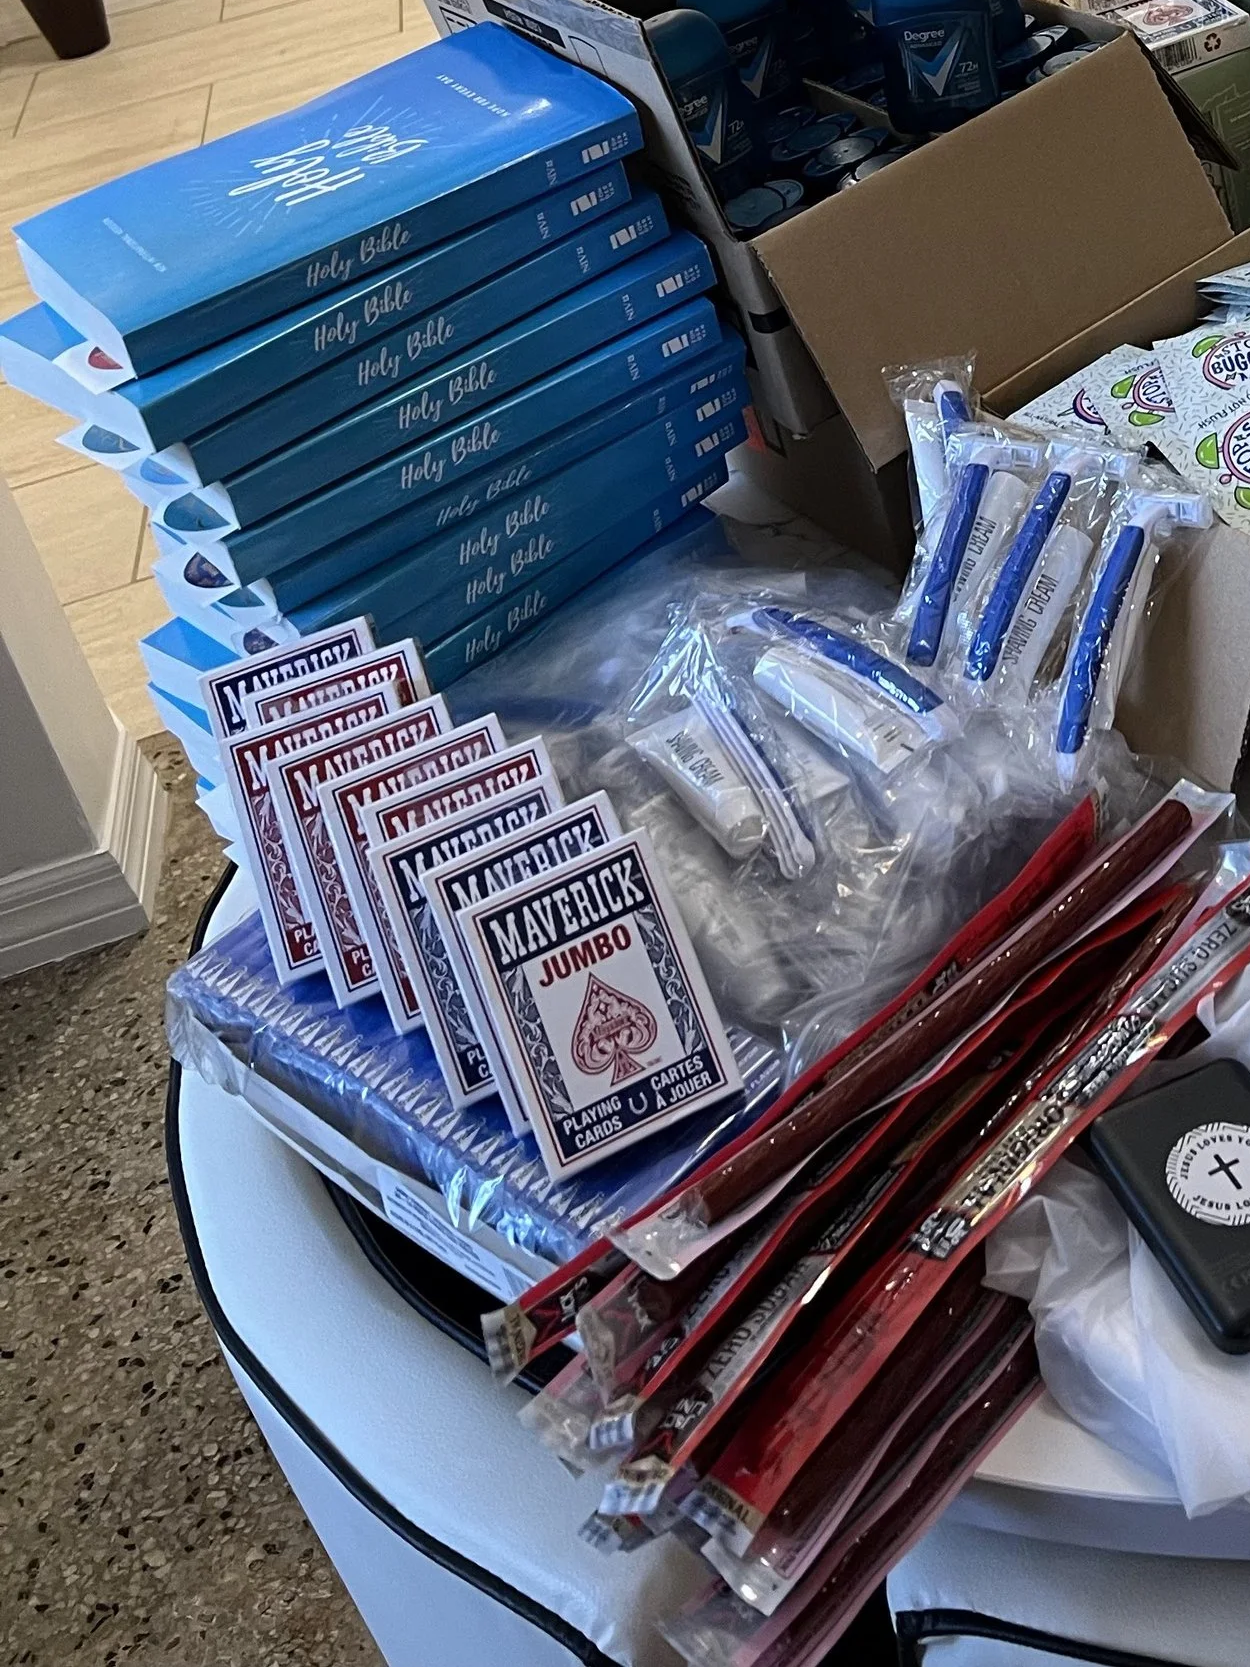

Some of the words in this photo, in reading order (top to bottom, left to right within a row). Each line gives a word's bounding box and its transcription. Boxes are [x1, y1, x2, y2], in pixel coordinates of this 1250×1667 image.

[904, 28, 945, 42] Degree
[228, 138, 364, 207] Holy
[307, 248, 354, 287] Holy
[360, 224, 411, 264] Bible
[314, 309, 358, 352] Holy
[364, 282, 412, 326] Bible
[358, 346, 401, 386] Holy
[407, 316, 454, 359] Bible
[399, 391, 442, 430] Holy
[449, 361, 497, 404] Bible
[1197, 405, 1229, 430] FLUSH
[1229, 396, 1247, 412] NOT
[401, 449, 446, 490] Holy
[451, 421, 500, 464] Bible
[460, 526, 501, 565] Holy
[505, 494, 550, 537] Bible
[466, 564, 507, 605] Holy
[510, 533, 555, 575] Bible
[465, 625, 501, 663] Holy
[507, 589, 548, 631] Bible
[1002, 615, 1039, 666] SHAVING
[1026, 573, 1060, 616] CREAM
[489, 857, 646, 966] MAVERICK
[539, 922, 633, 988] JUMBO
[651, 1054, 705, 1092] CARTES
[669, 1071, 713, 1105] JOUER
[562, 1095, 622, 1136] PLAYING
[575, 1114, 623, 1150] CARDS
[1180, 1147, 1198, 1180] JESUS
[1196, 1133, 1234, 1152] LOVES
[1192, 1193, 1232, 1212] JESUS
